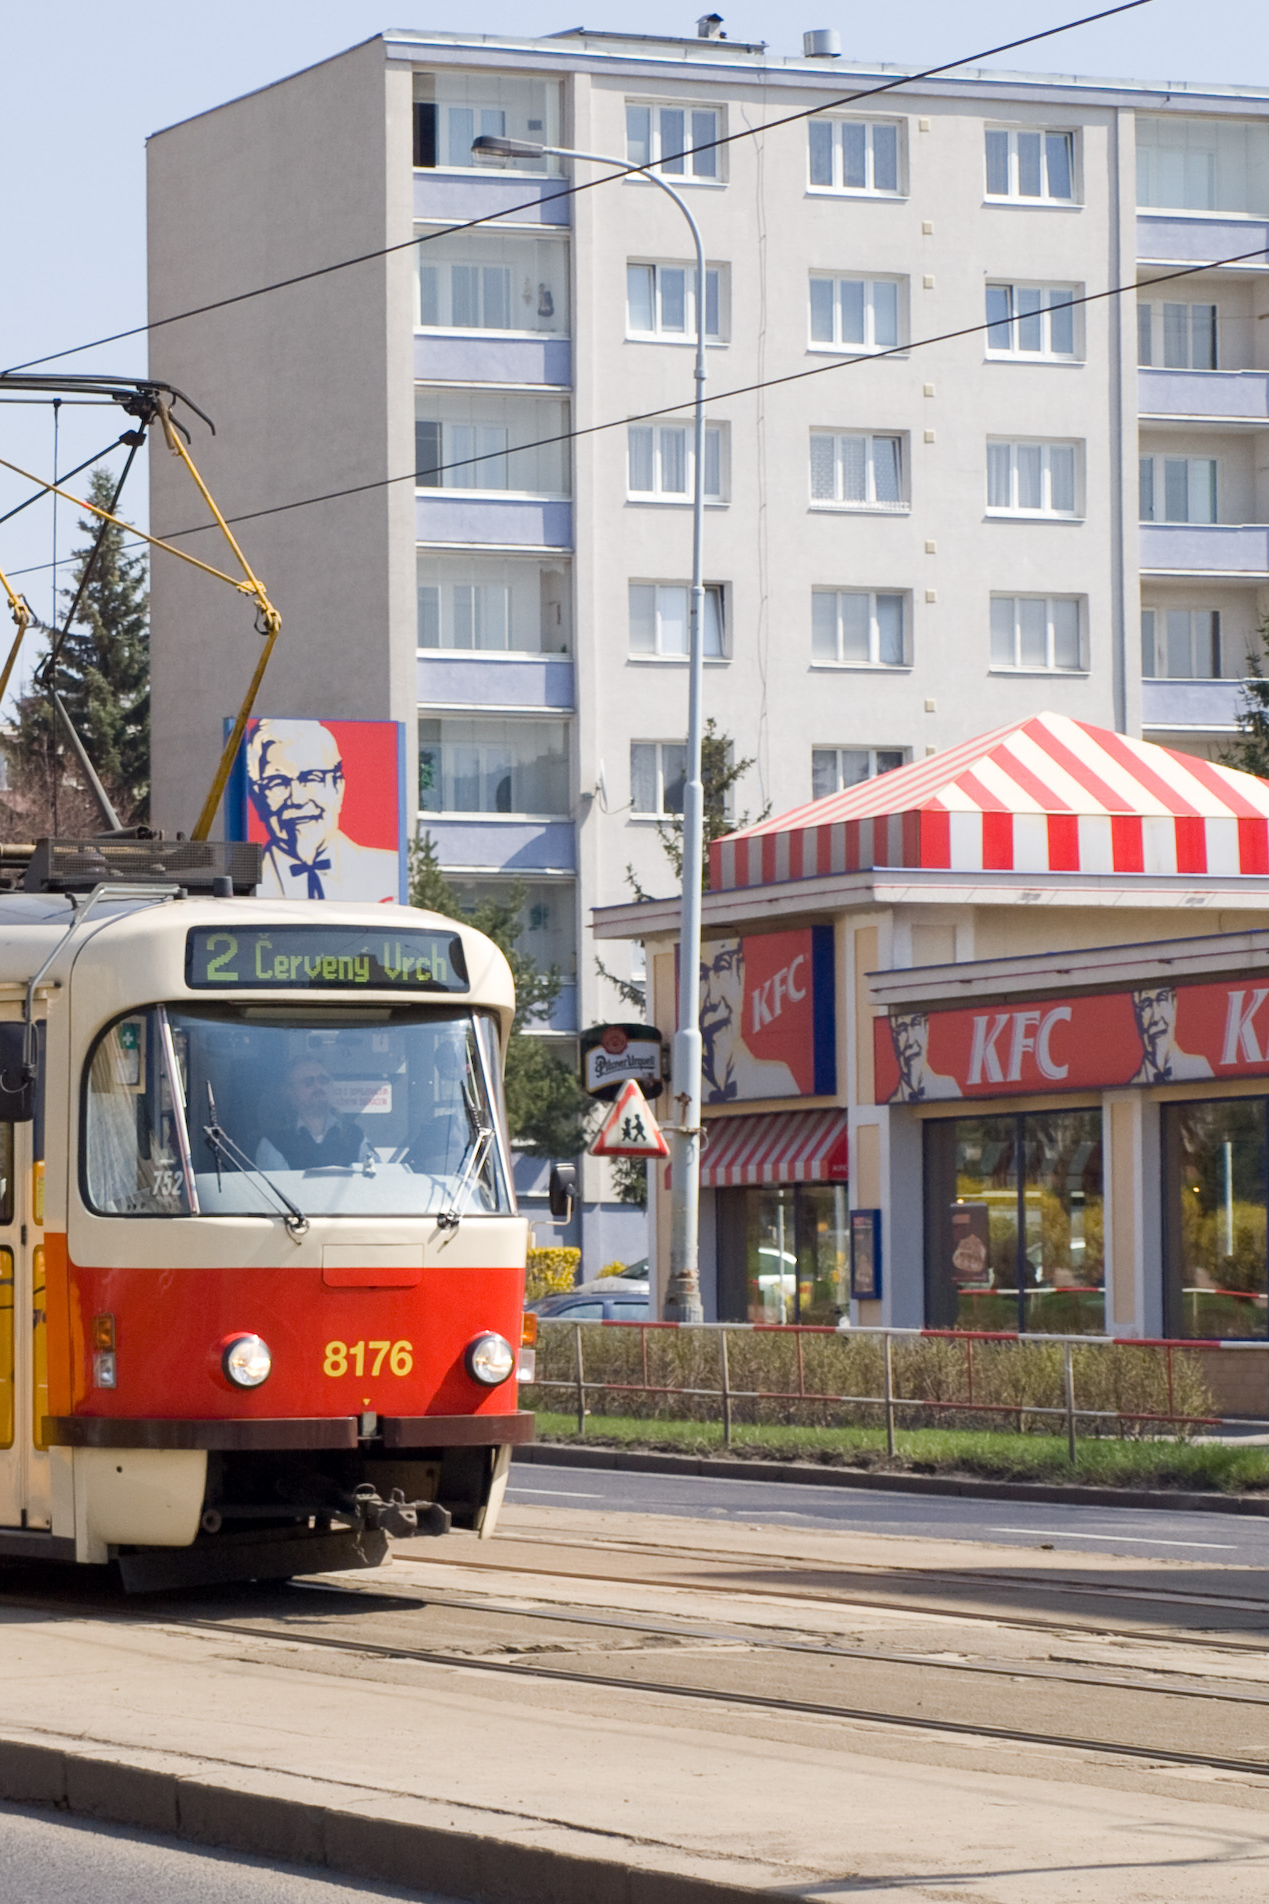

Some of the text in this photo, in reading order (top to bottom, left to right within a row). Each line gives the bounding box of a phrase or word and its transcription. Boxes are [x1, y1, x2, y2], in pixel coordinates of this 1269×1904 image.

[207, 932, 447, 983] 2 Červený Vrch
[751, 953, 807, 1035] KFC
[1219, 987, 1269, 1065] K
[966, 1006, 1072, 1085] KFC
[152, 1170, 184, 1196] 752
[323, 1340, 414, 1377] 8176
